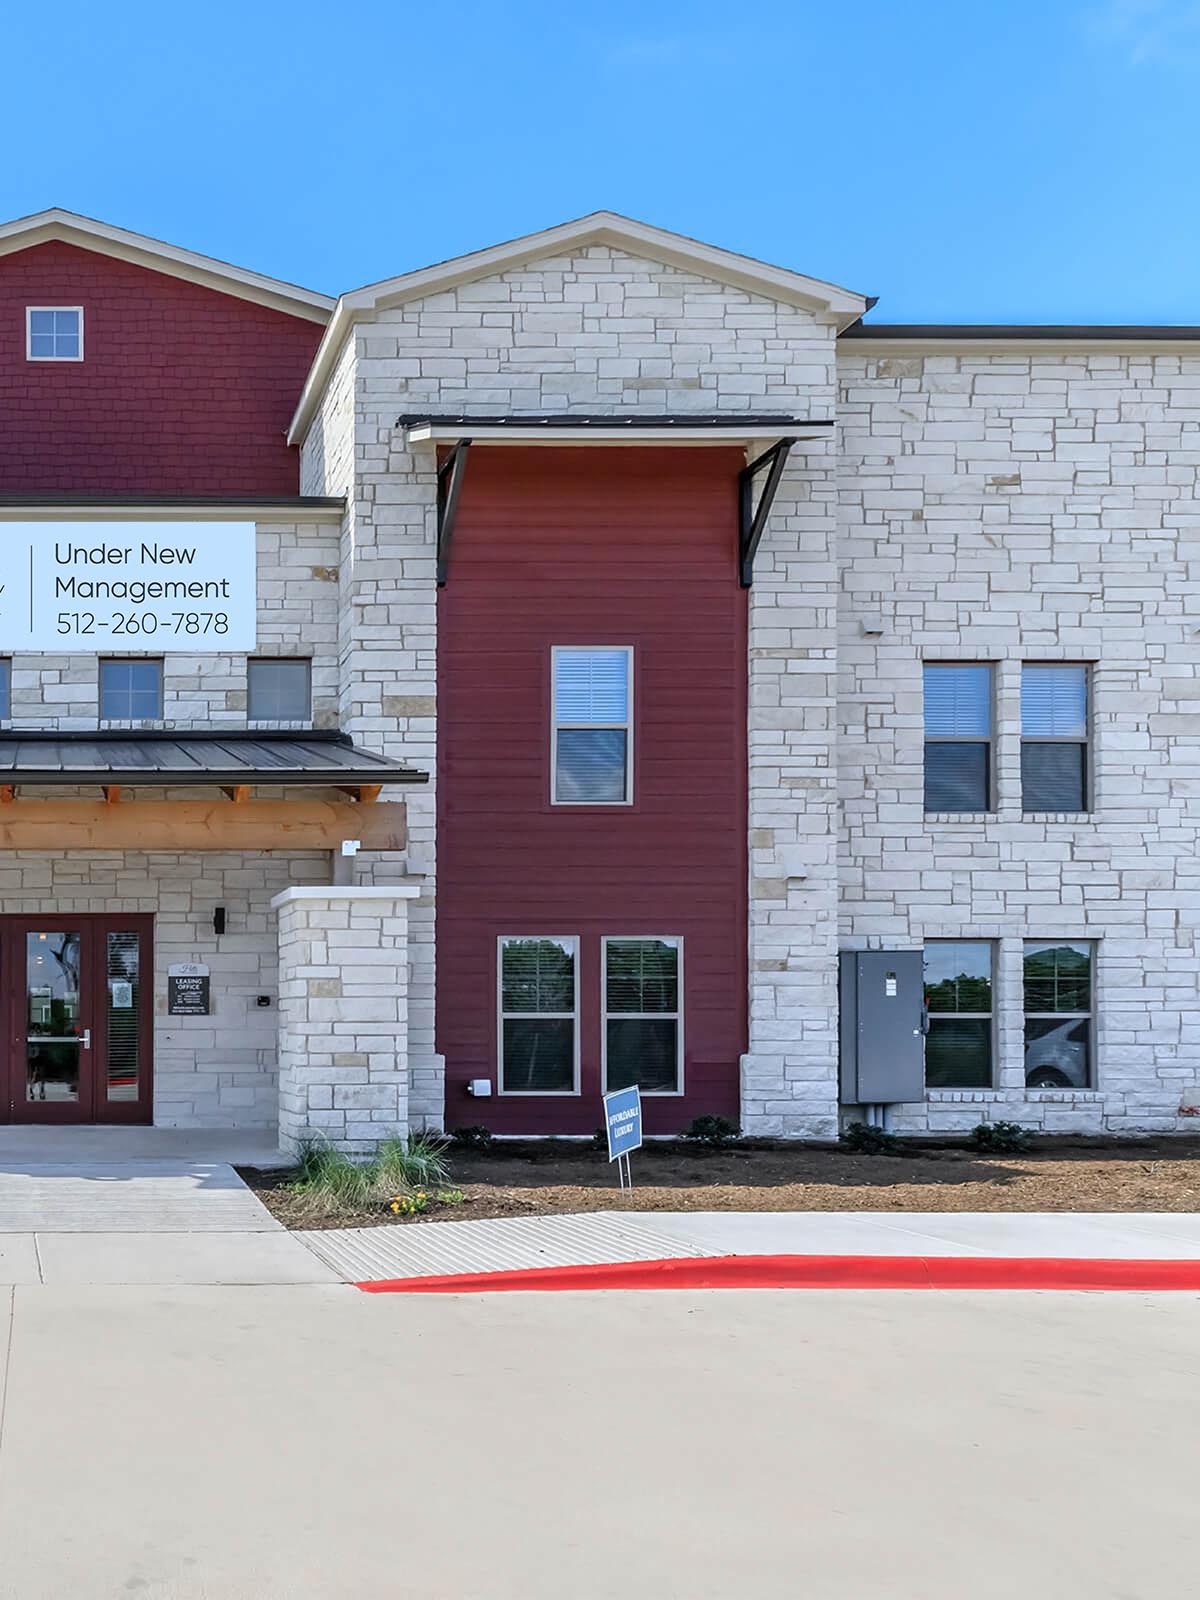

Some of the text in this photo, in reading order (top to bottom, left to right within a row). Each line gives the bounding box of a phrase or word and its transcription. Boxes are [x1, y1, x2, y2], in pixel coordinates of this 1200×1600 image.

[55, 543, 196, 564] Under New
[55, 576, 230, 603] Management
[57, 612, 229, 634] 512-260-7878
